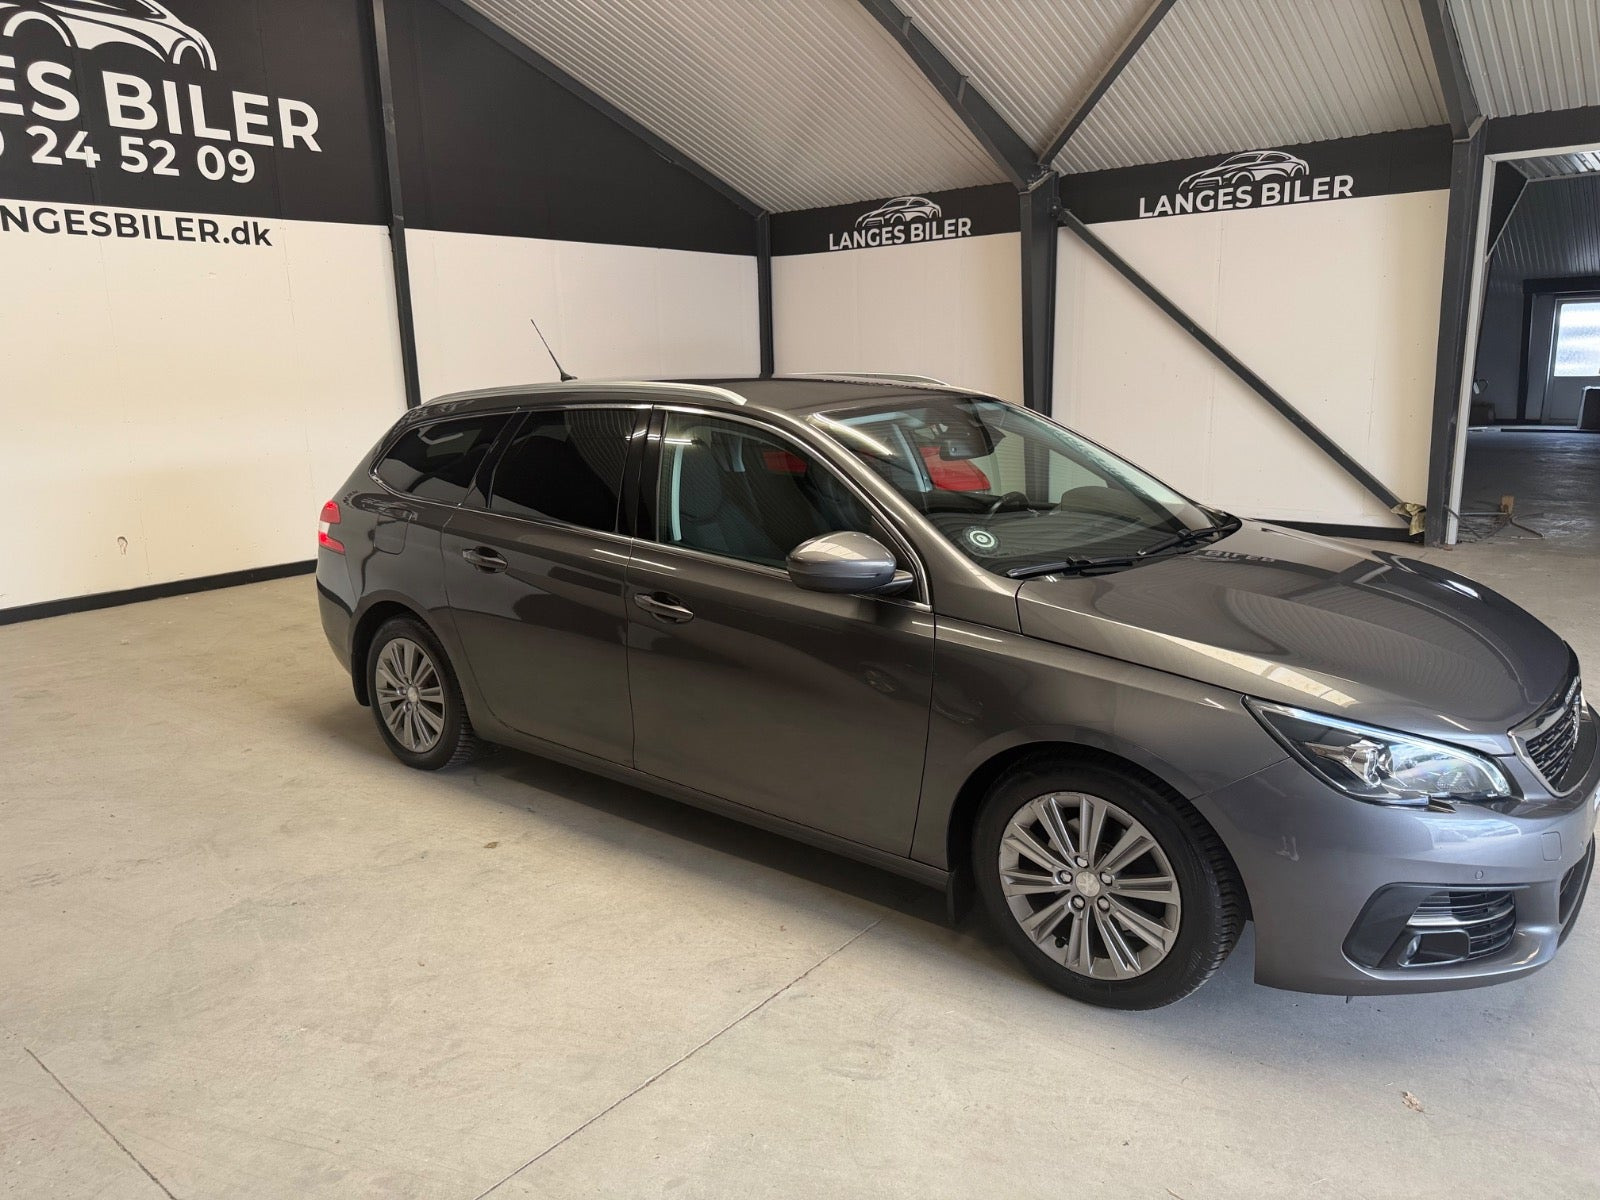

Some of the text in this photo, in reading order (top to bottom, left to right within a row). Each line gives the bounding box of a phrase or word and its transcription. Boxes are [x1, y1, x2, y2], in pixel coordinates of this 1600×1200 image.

[101, 70, 322, 152] BILER
[25, 125, 101, 168] 24
[120, 135, 180, 176] 52
[197, 144, 256, 184] 09
[1139, 175, 1354, 217] LANGES BILER
[0, 205, 273, 246] NGESBILER.dk
[829, 217, 972, 250] LANGES BILER
